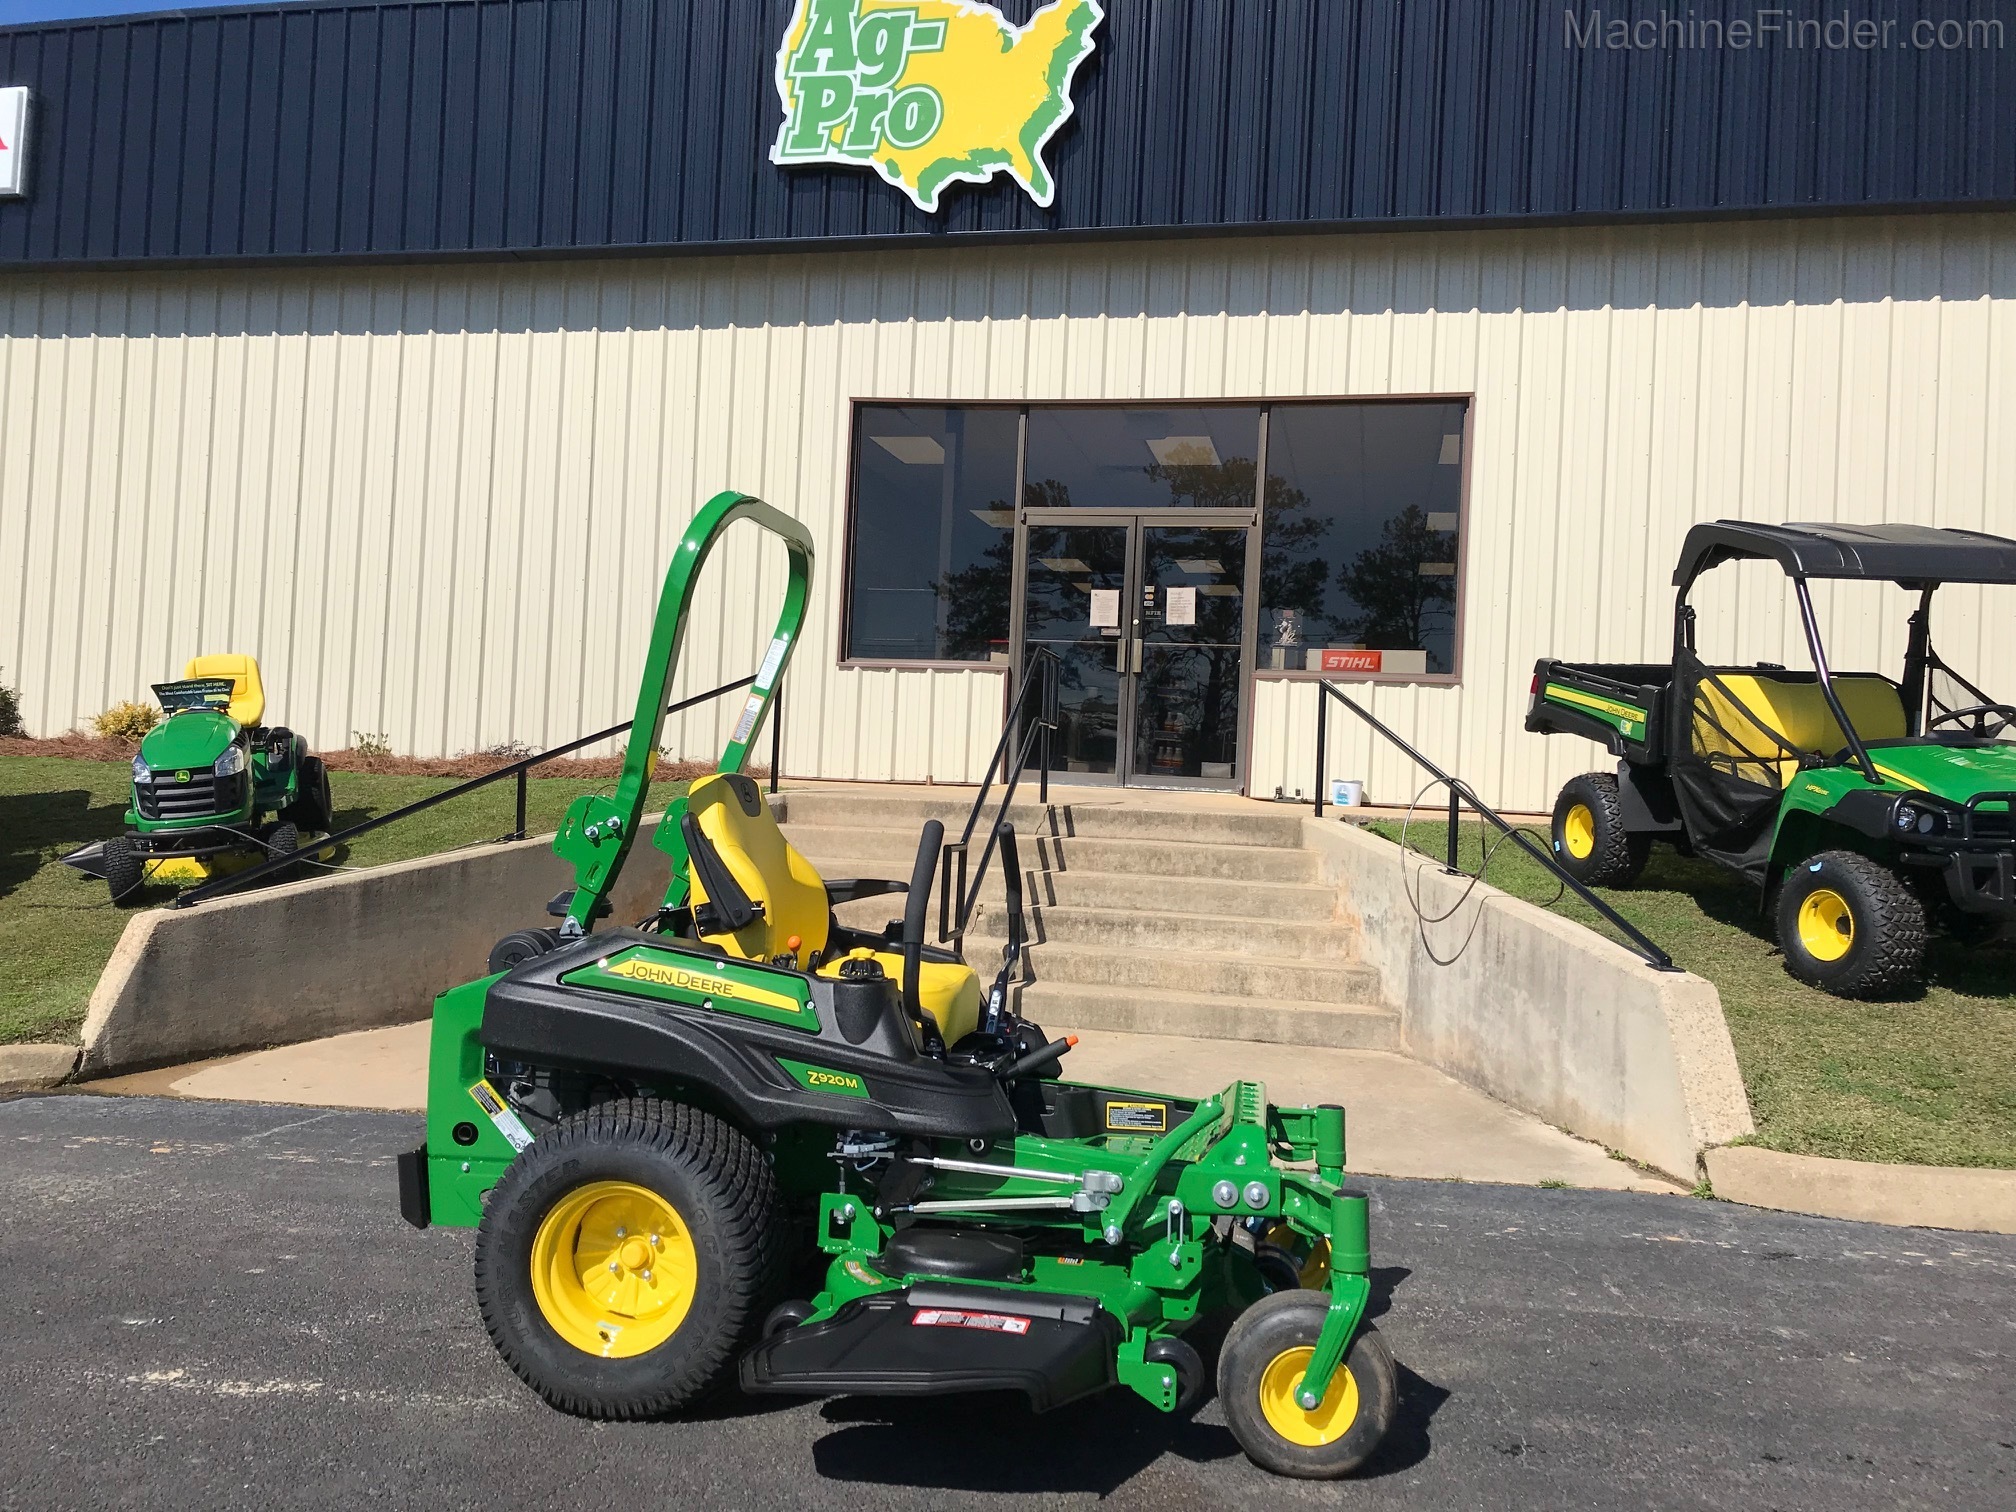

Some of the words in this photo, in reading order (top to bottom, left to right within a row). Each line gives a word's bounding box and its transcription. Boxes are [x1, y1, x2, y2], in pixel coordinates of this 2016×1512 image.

[790, 0, 946, 88] Ag-
[783, 73, 943, 155] Pro
[1326, 656, 1375, 669] STIHL
[1607, 704, 1620, 714] JOHN
[1621, 708, 1639, 721] DEERE
[625, 962, 673, 985] JOHN
[676, 970, 734, 996] DEERE
[807, 1070, 858, 1089] Z920M
